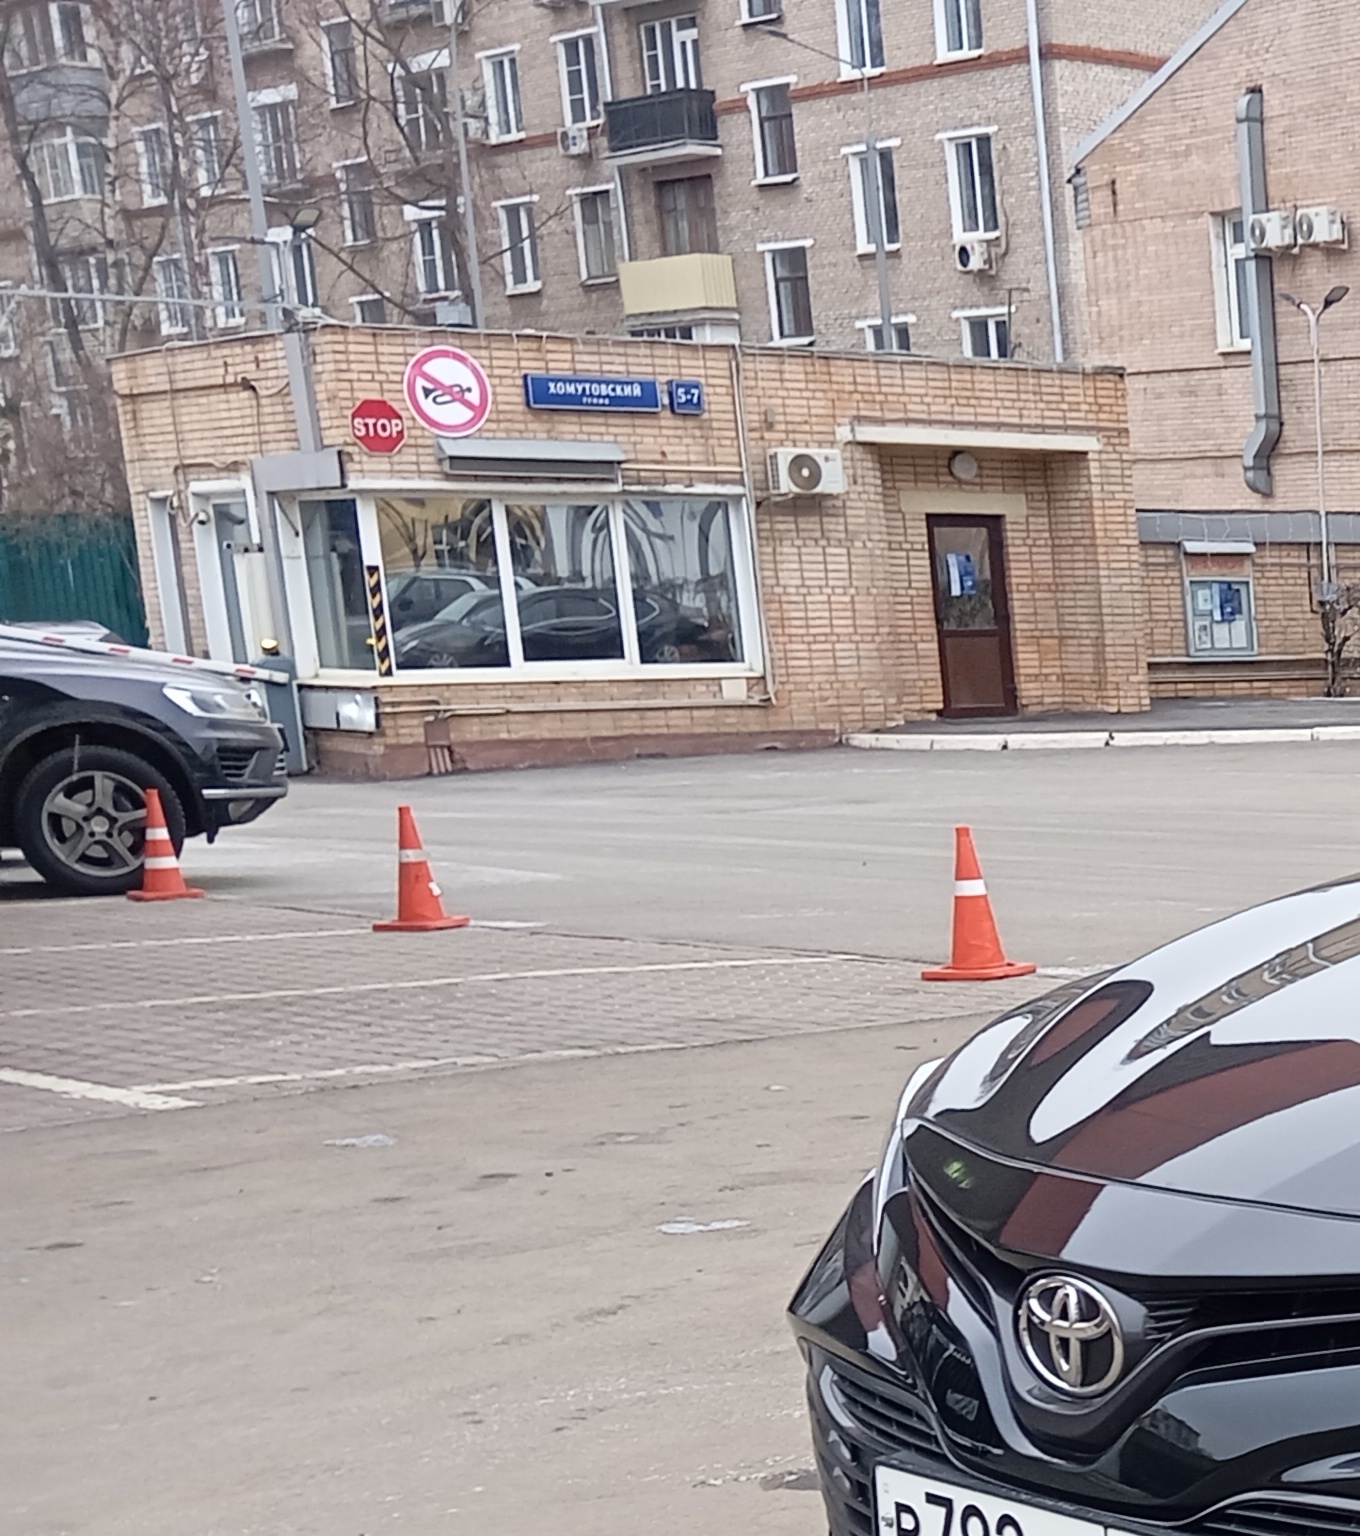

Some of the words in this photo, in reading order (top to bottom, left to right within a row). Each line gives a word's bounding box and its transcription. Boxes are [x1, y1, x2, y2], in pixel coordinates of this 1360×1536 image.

[548, 381, 642, 397] ХОМУТОВСКИЙ
[677, 388, 700, 405] 5-7
[353, 417, 403, 438] STOP
